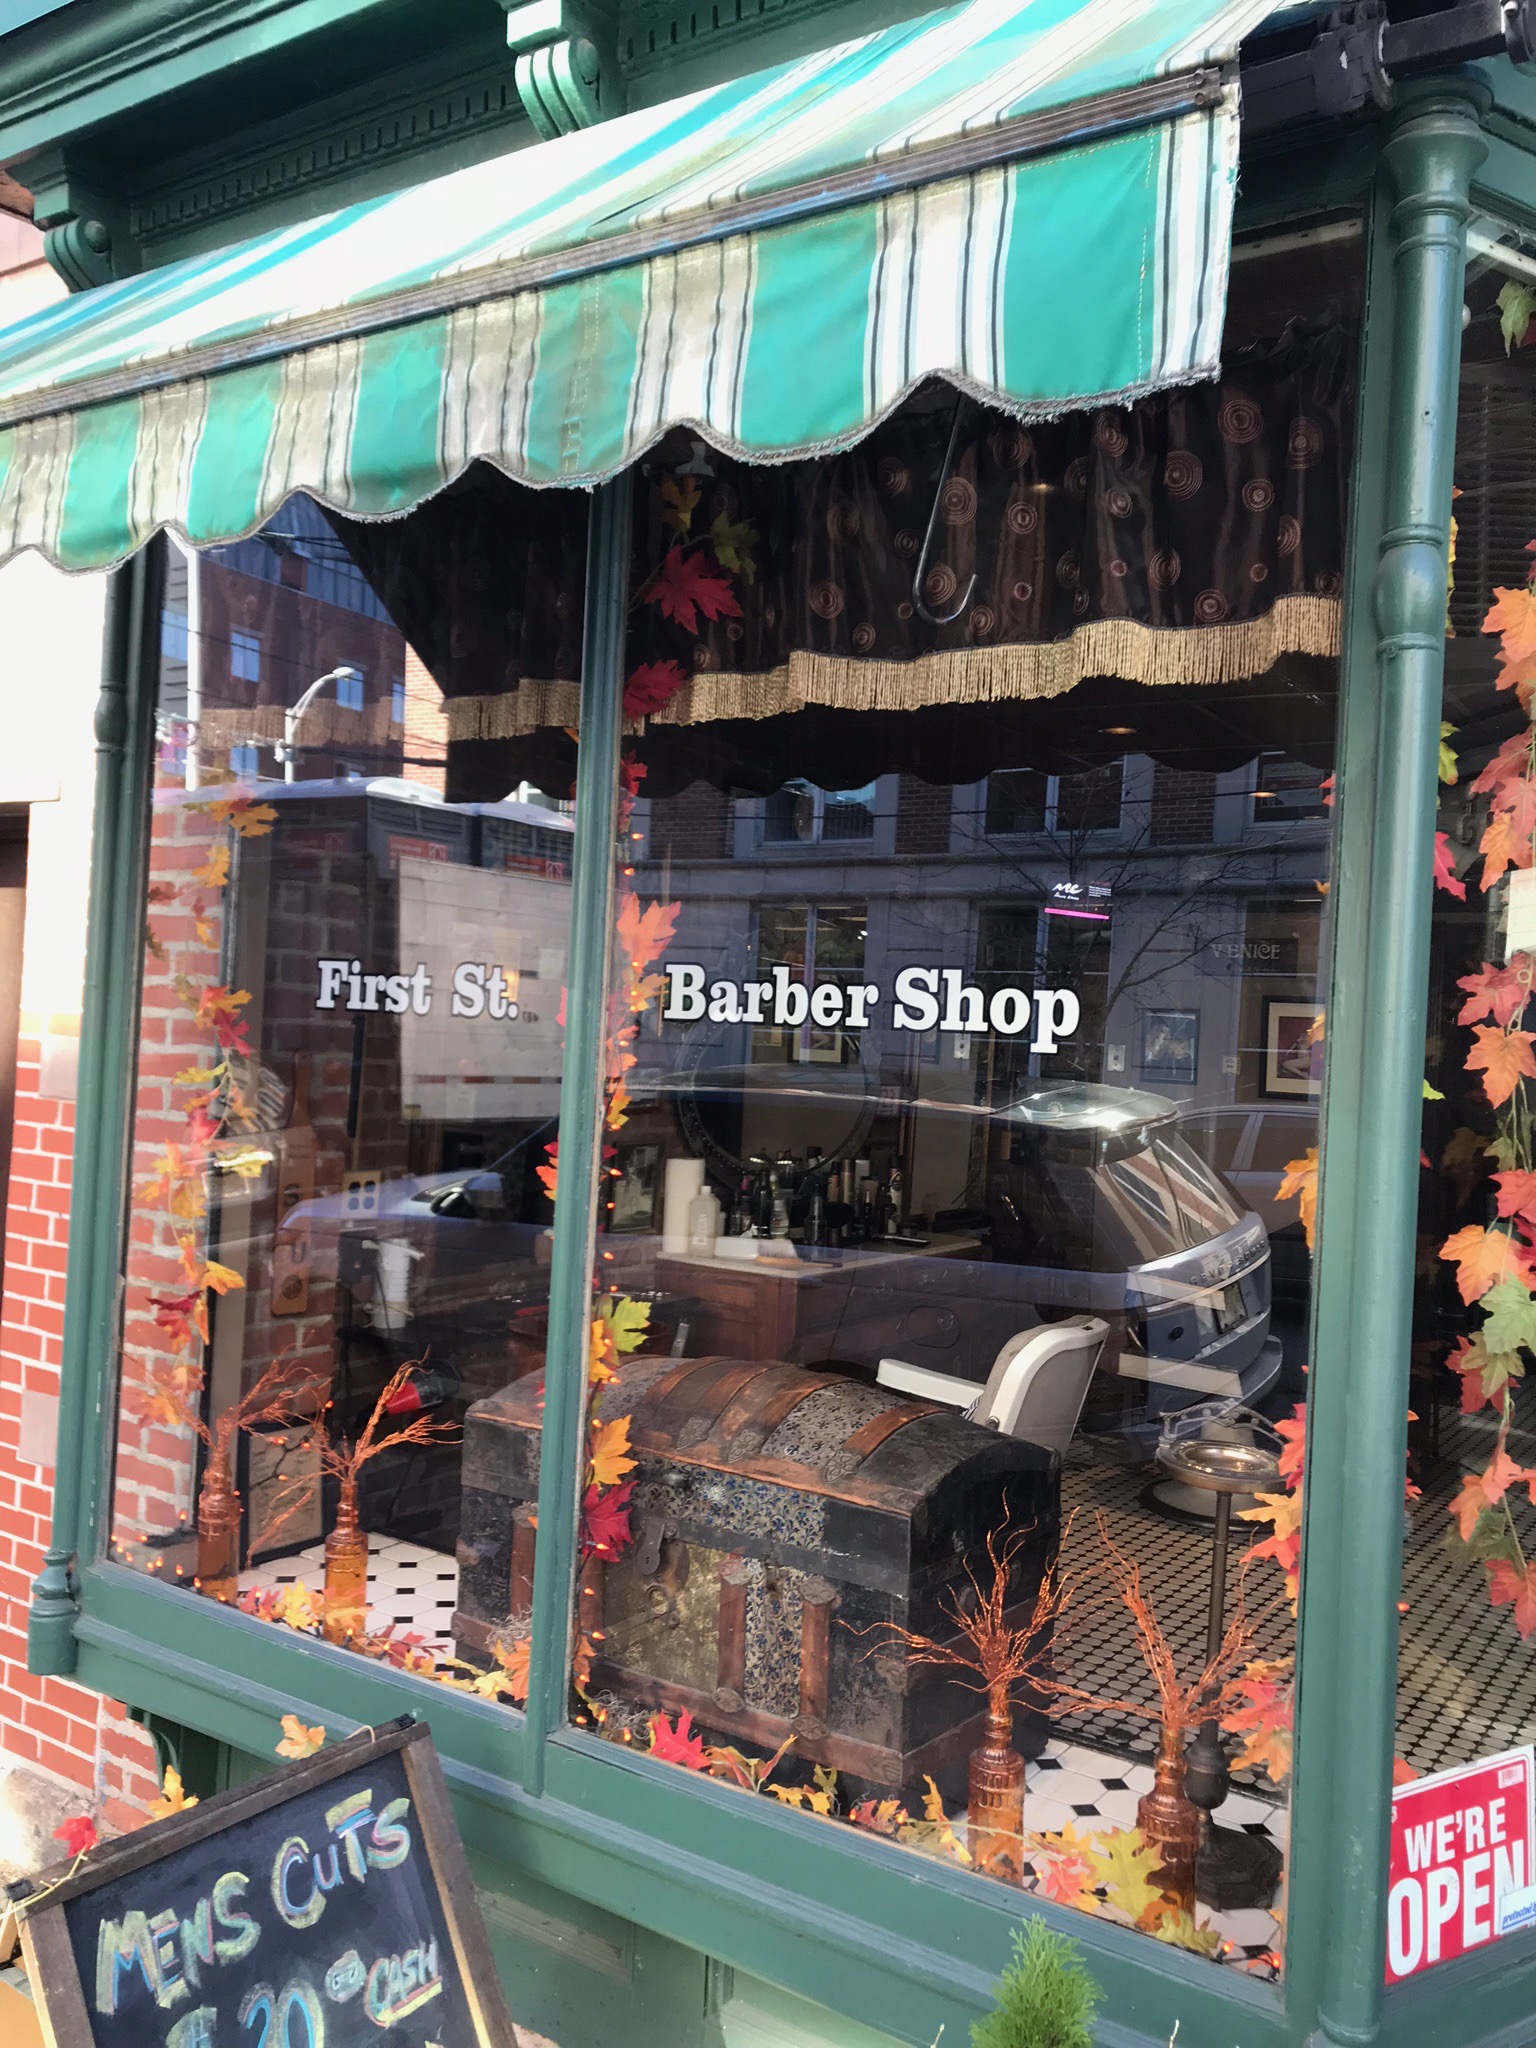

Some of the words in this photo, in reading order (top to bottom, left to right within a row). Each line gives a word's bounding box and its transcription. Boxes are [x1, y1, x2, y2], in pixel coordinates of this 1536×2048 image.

[1210, 943, 1282, 960] VENICE
[314, 957, 432, 1015] First
[451, 961, 519, 1020] St.
[663, 962, 879, 1029] Barber
[892, 964, 1082, 1056] Shop
[1404, 1797, 1506, 1873] WE'RE
[95, 1870, 262, 2015] MENS
[1387, 1839, 1524, 1976] OPEN
[363, 1936, 440, 2028] CASH
